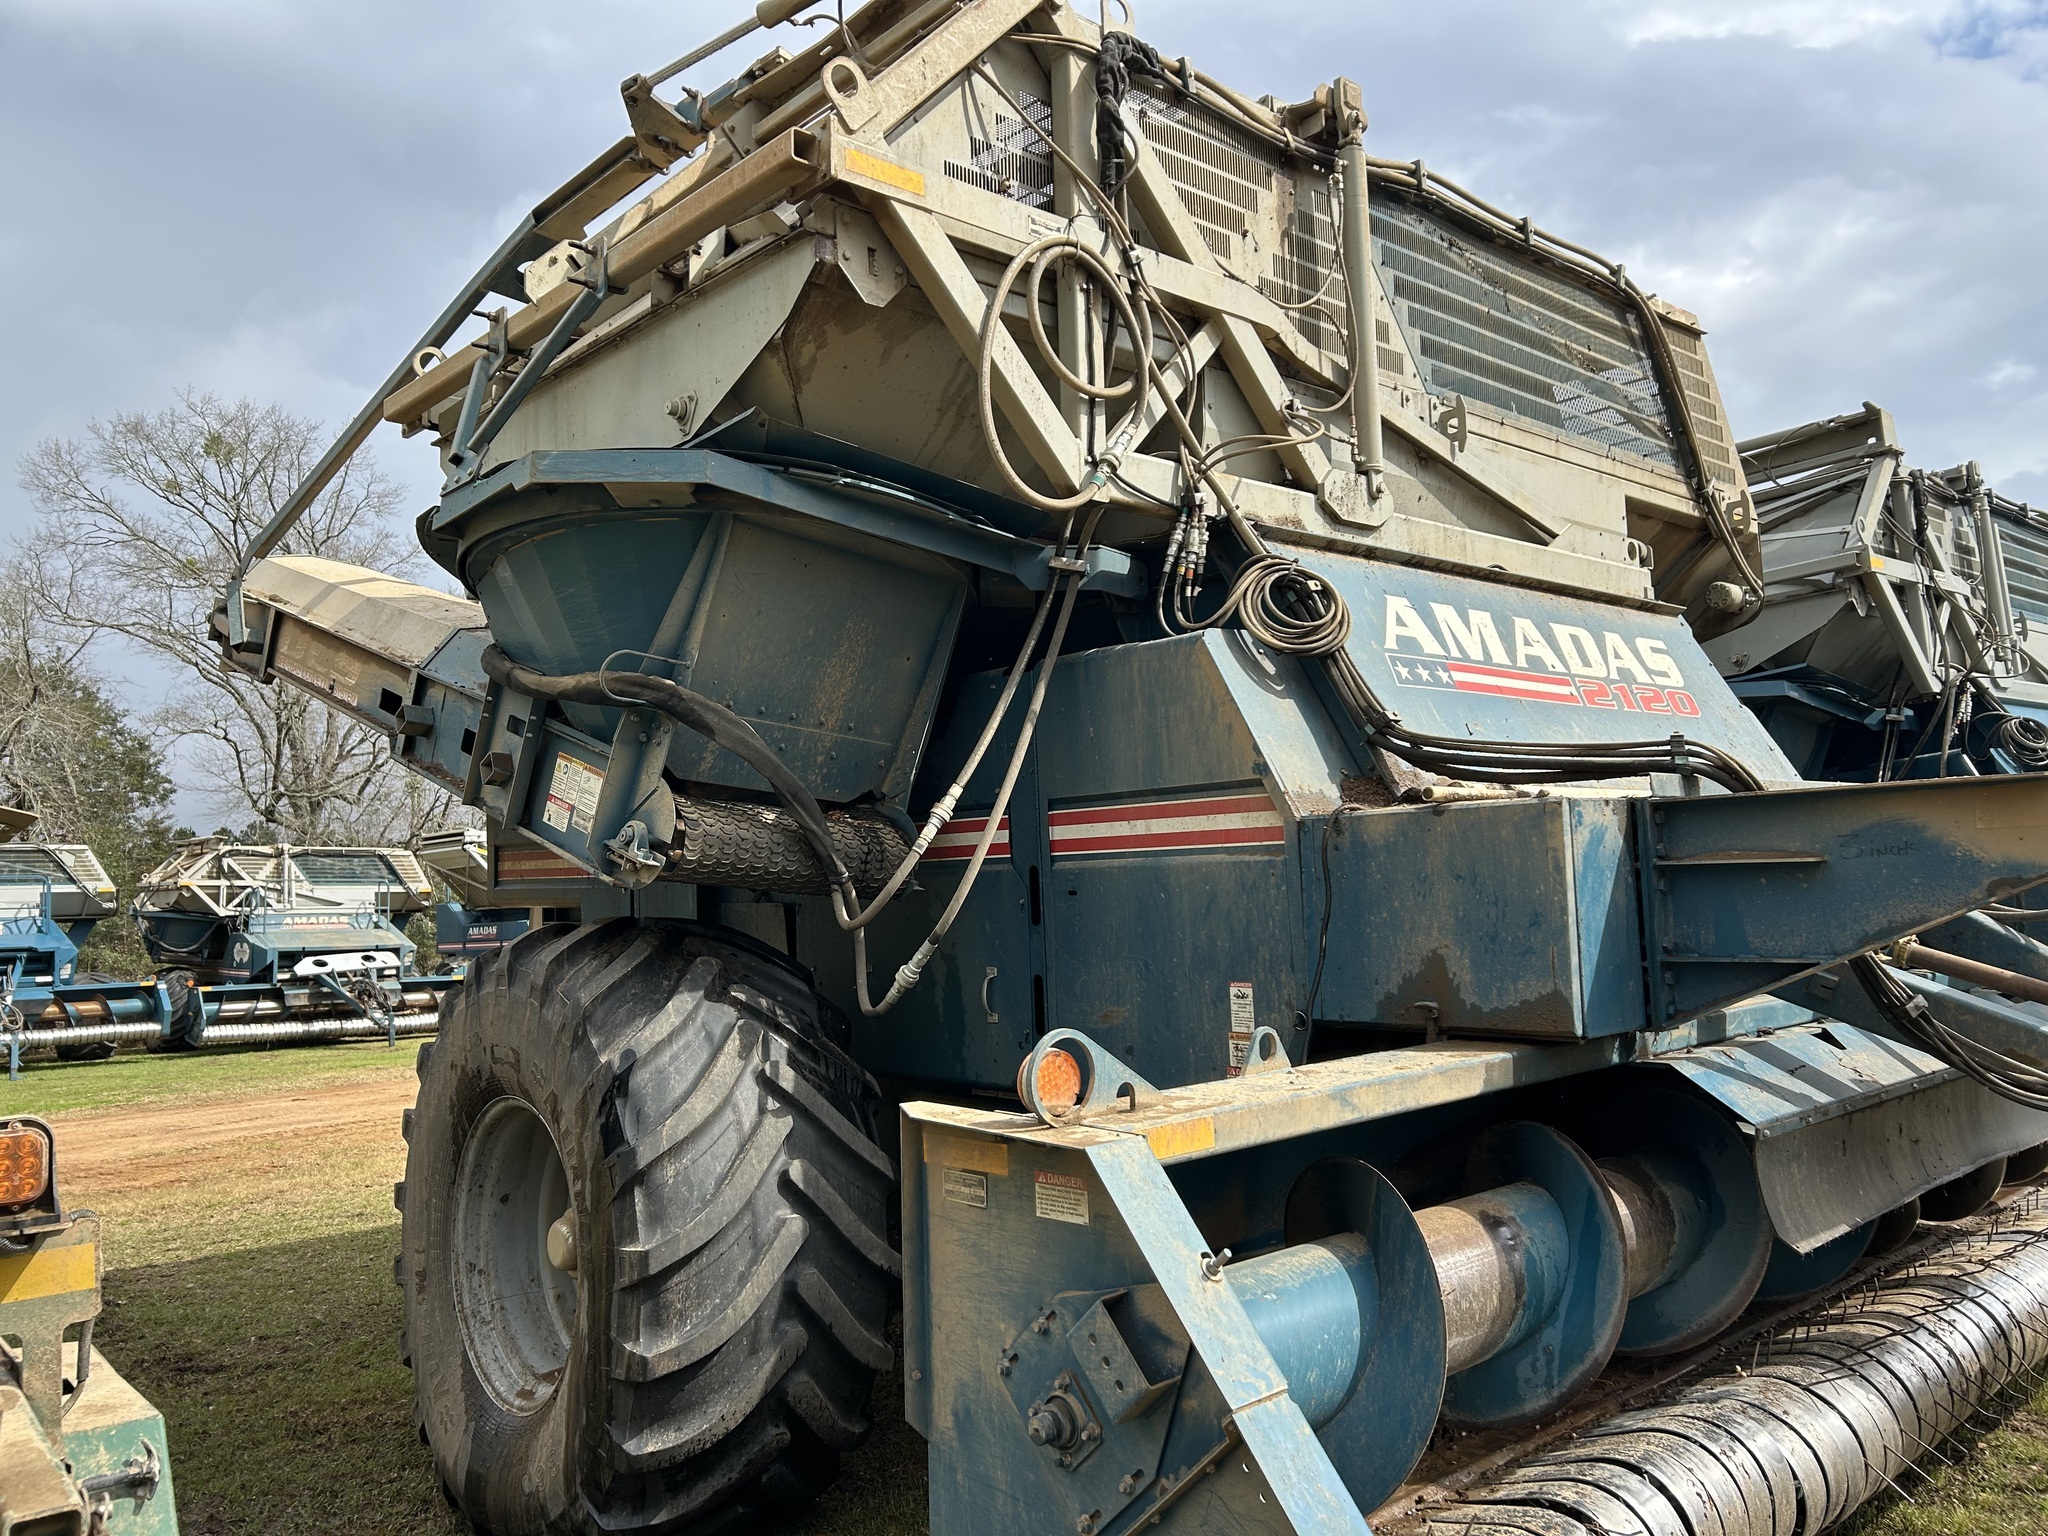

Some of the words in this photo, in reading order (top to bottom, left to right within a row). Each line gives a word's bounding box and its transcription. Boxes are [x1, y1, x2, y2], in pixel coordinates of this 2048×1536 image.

[1384, 594, 1684, 688] AMADAS
[1577, 679, 1701, 718] 2120
[282, 916, 349, 925] AMADAS
[467, 925, 498, 936] AMADAS
[1047, 1173, 1083, 1189] DANGER
